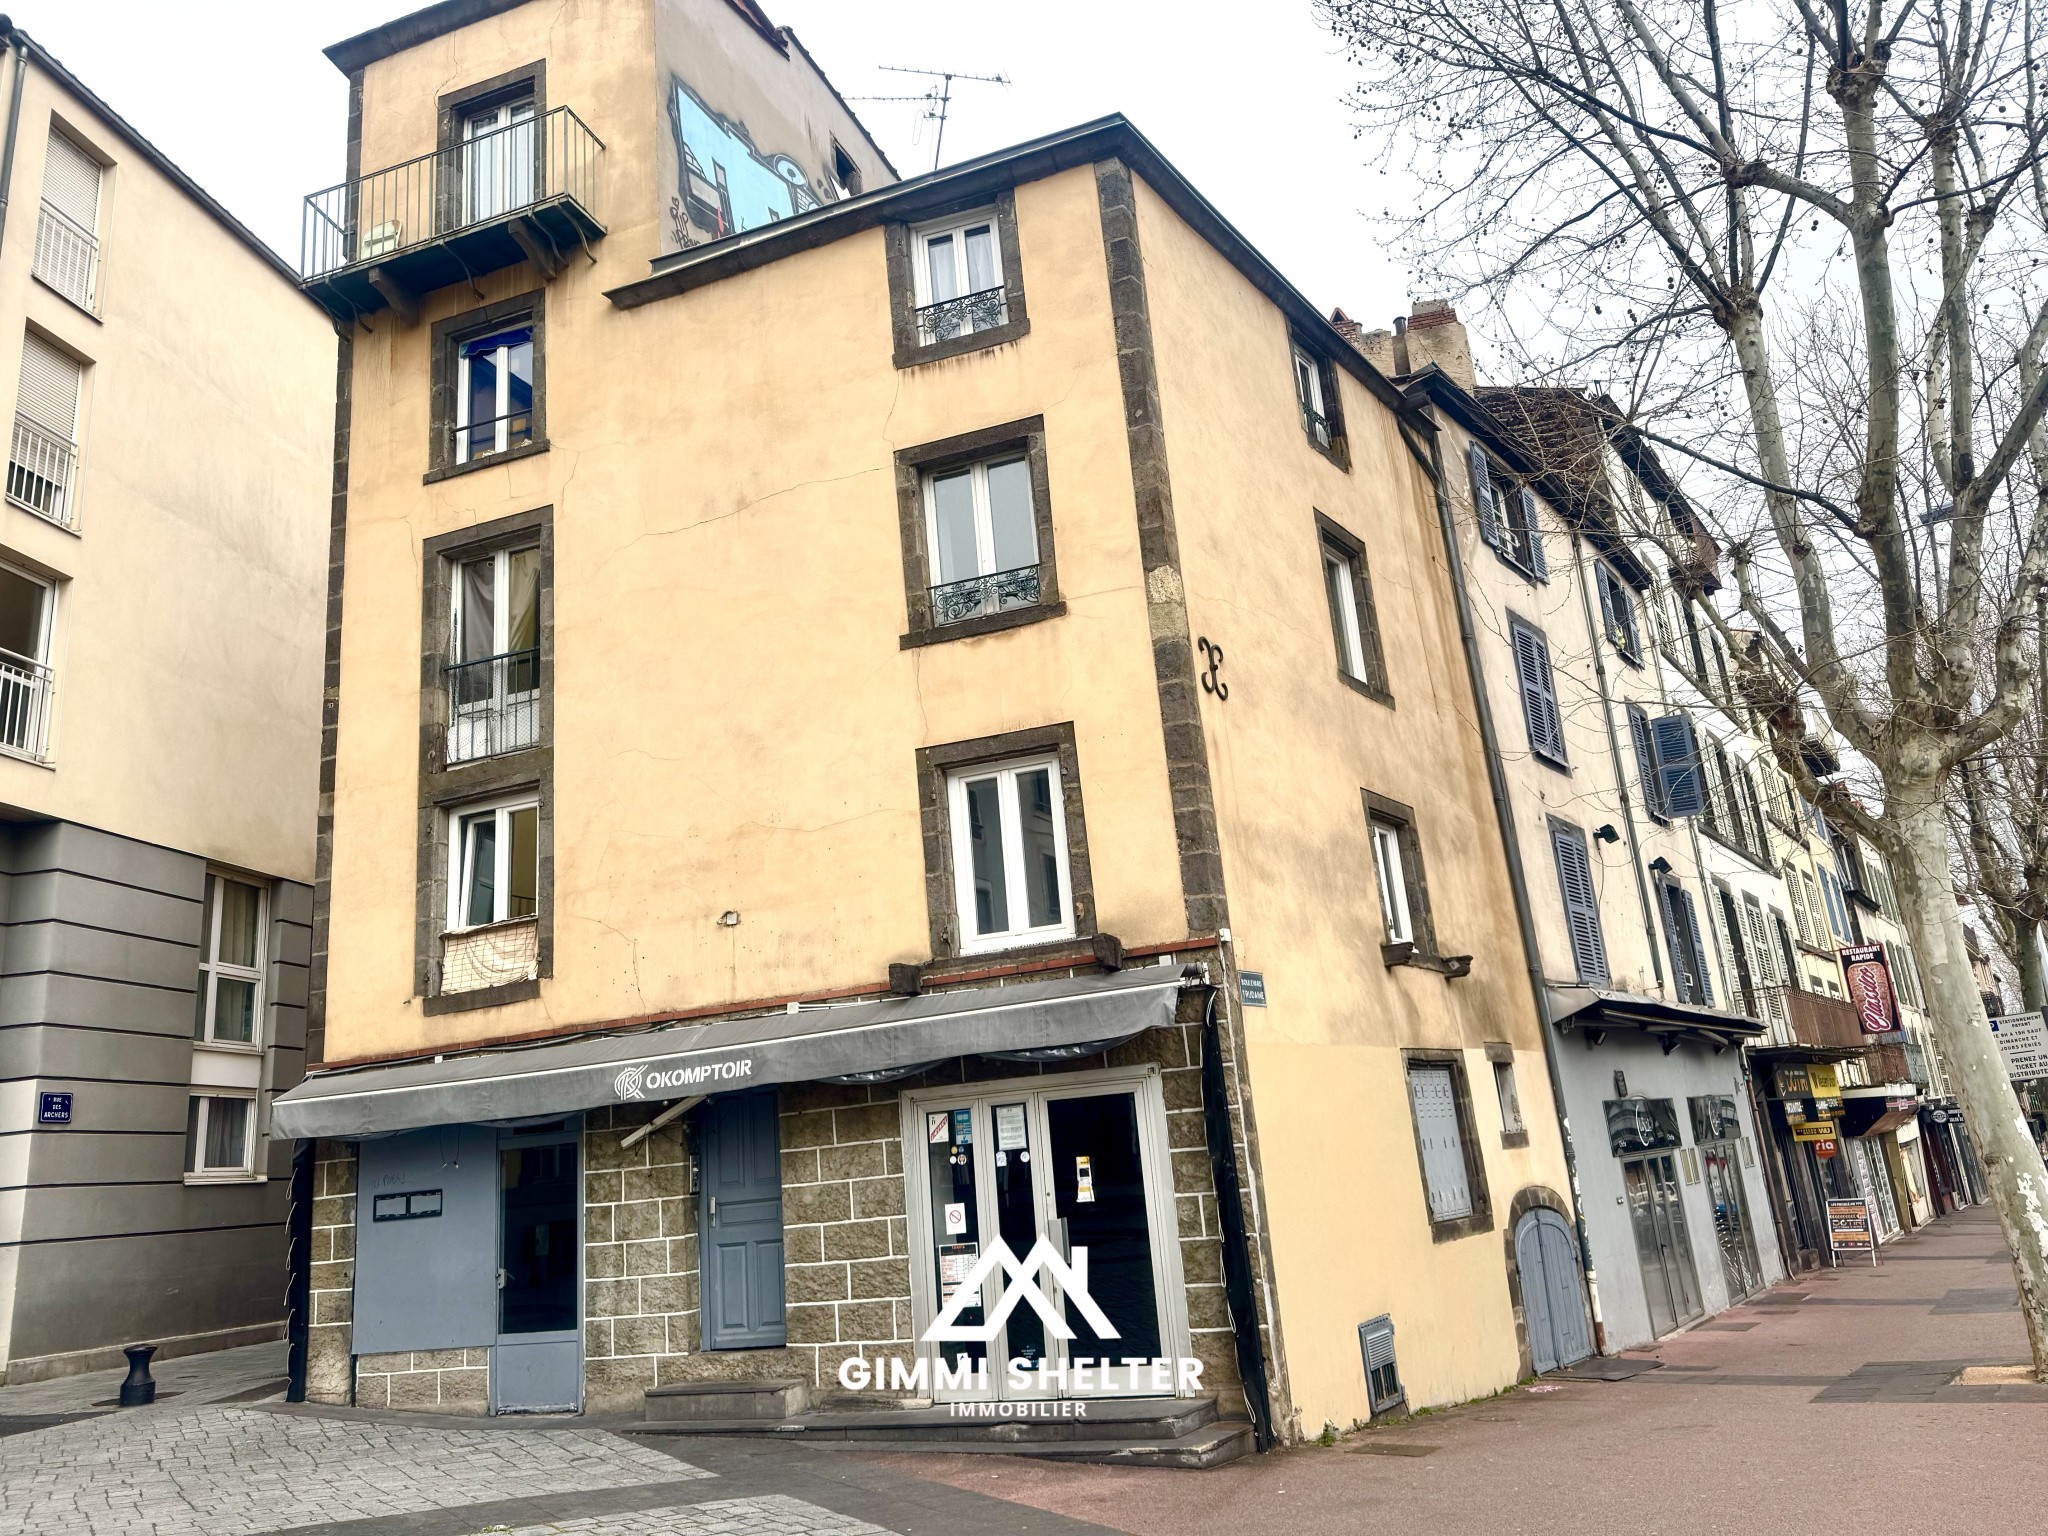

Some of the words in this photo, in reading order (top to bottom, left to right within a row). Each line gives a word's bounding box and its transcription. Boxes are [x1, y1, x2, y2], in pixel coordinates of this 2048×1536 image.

[1841, 945, 1880, 956] RESTAURANT
[1851, 953, 1874, 961] RAPIDE
[1999, 1014, 2042, 1025] STATIONNEMENT
[2000, 1036, 2029, 1045] DIMANCHE
[2010, 1055, 2037, 1064] PRENEZ
[2014, 1062, 2037, 1071] TICKET
[646, 1059, 752, 1089] OKOMPTOIR
[1815, 1139, 1834, 1150] ria
